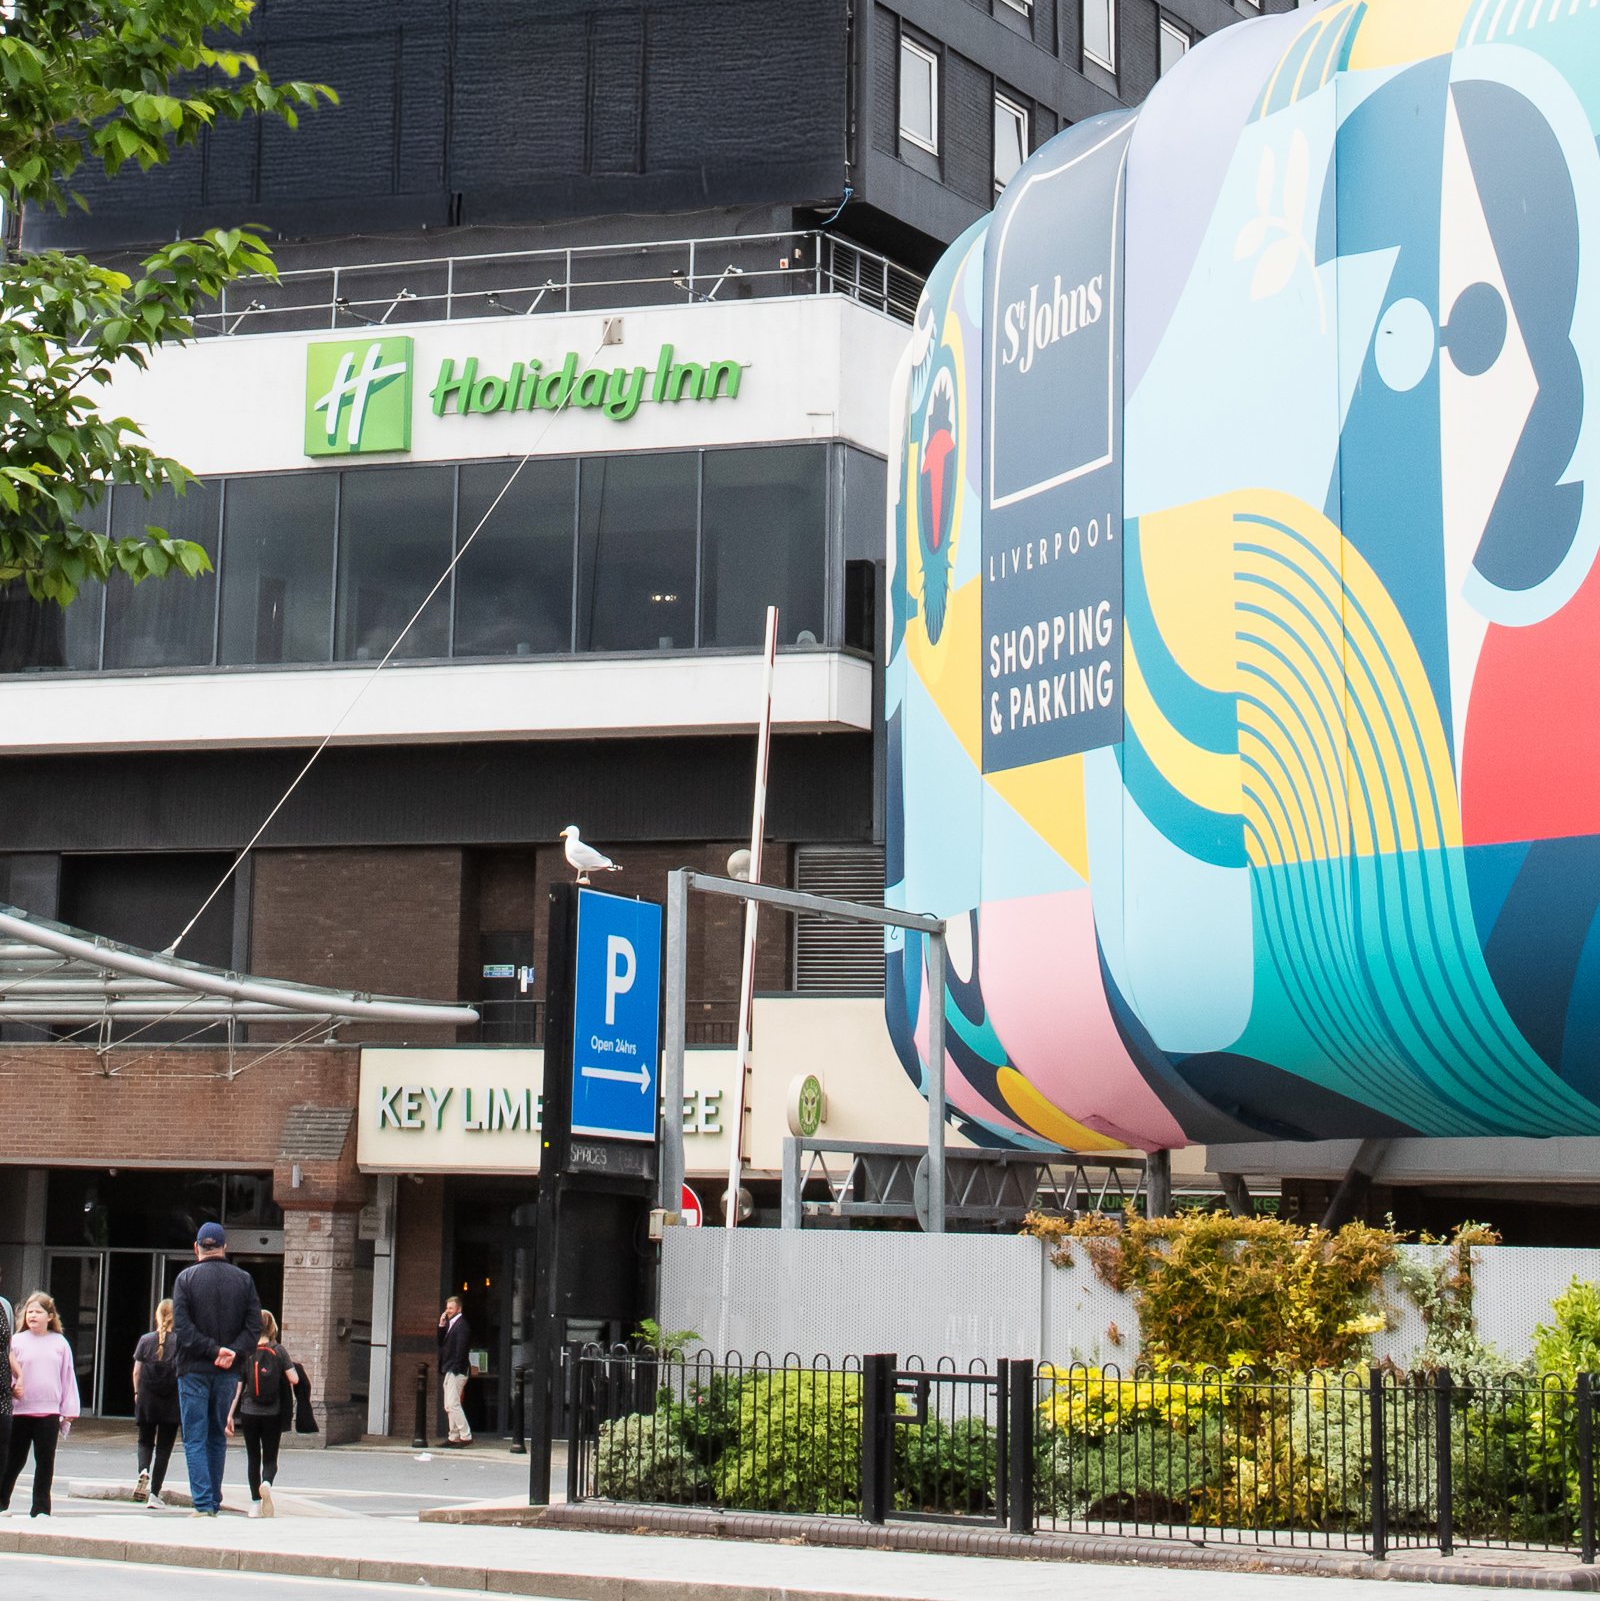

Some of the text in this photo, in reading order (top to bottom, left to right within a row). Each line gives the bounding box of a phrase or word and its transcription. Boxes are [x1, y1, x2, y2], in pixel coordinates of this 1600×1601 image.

[430, 351, 646, 422] Holiday
[650, 343, 744, 404] Inn
[990, 513, 1114, 583] LIVERPOOL
[990, 599, 1113, 679] SHOPPING
[990, 660, 1113, 736] & PARKING
[605, 934, 637, 1026] P
[590, 1035, 637, 1055] Open 24hrs
[375, 1086, 454, 1131] KEY
